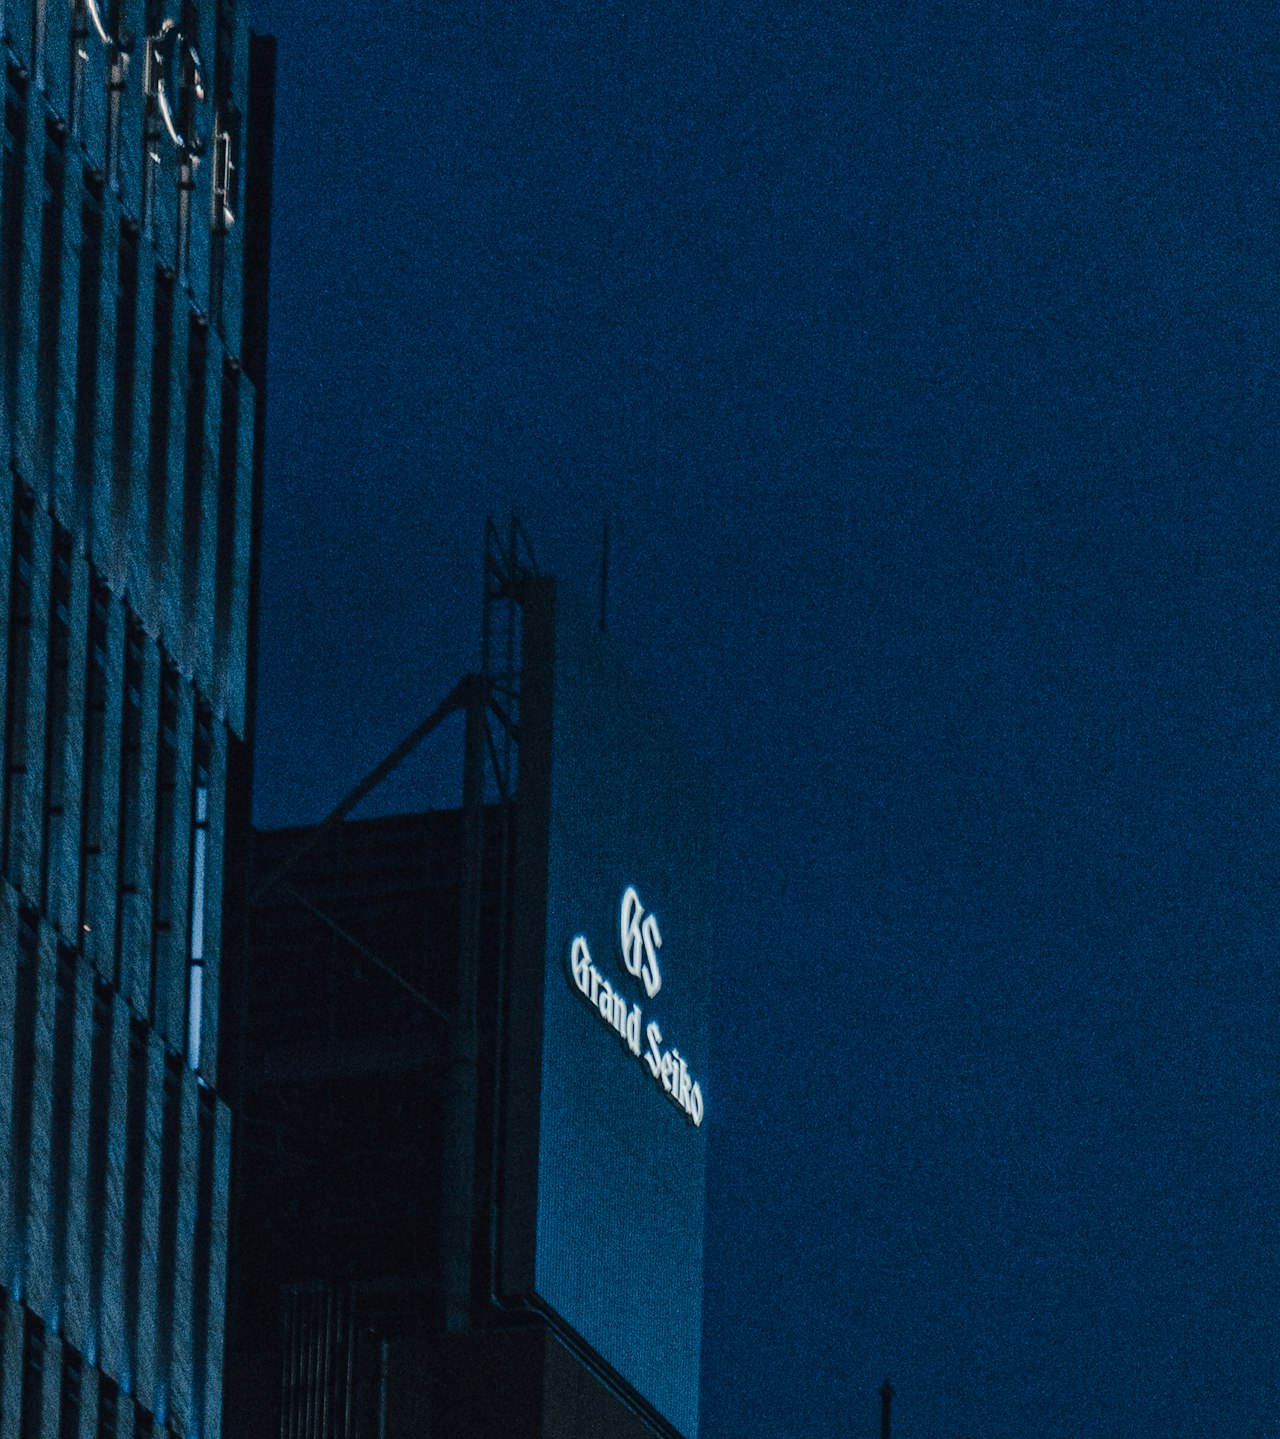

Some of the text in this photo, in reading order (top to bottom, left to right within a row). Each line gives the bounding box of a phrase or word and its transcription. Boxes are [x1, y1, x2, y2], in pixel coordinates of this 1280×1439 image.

[621, 886, 663, 999] GS
[571, 935, 705, 1128] Grand Seiko
